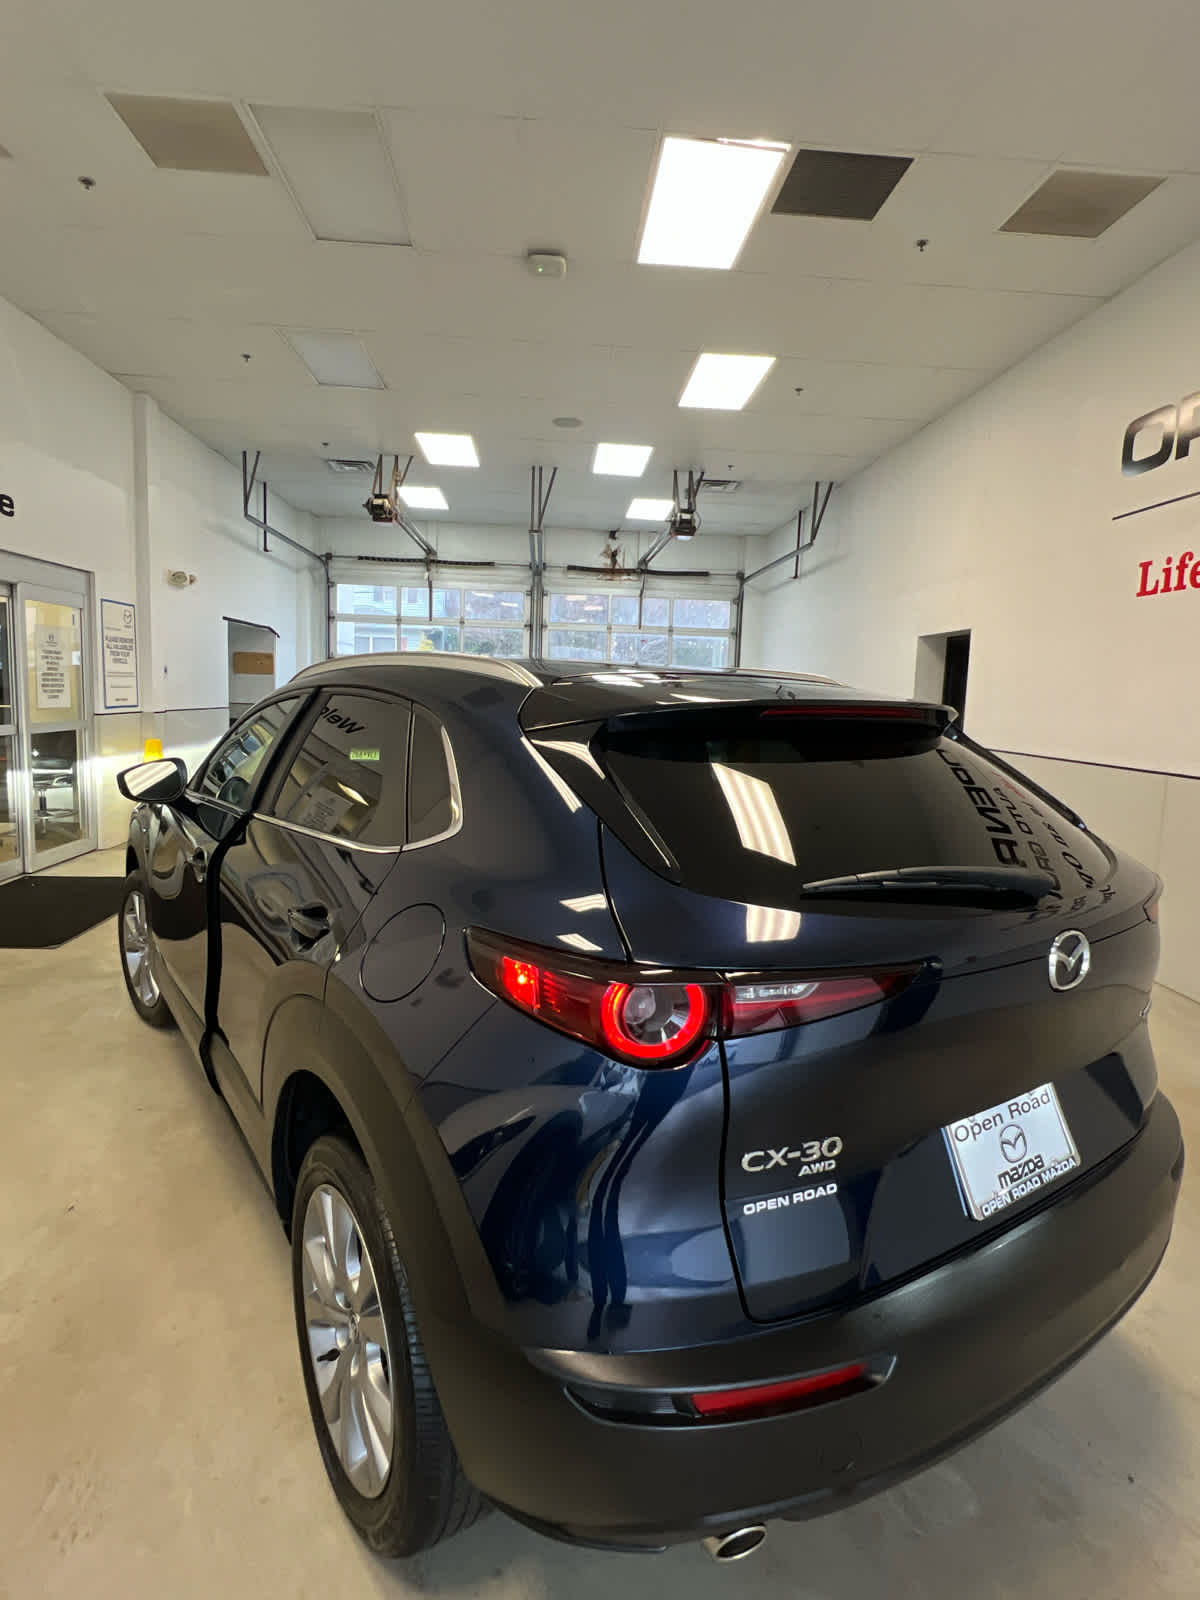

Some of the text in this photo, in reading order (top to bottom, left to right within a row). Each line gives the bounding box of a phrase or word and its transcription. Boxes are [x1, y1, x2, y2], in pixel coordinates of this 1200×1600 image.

[954, 1089, 1051, 1142] Open Road
[741, 1136, 843, 1172] CX-30
[798, 1159, 836, 1177] AWD
[998, 1154, 1045, 1189] mazda
[743, 1183, 838, 1215] OPEN ROAD
[982, 1156, 1077, 1217] OPEN ROAD MAZDA
